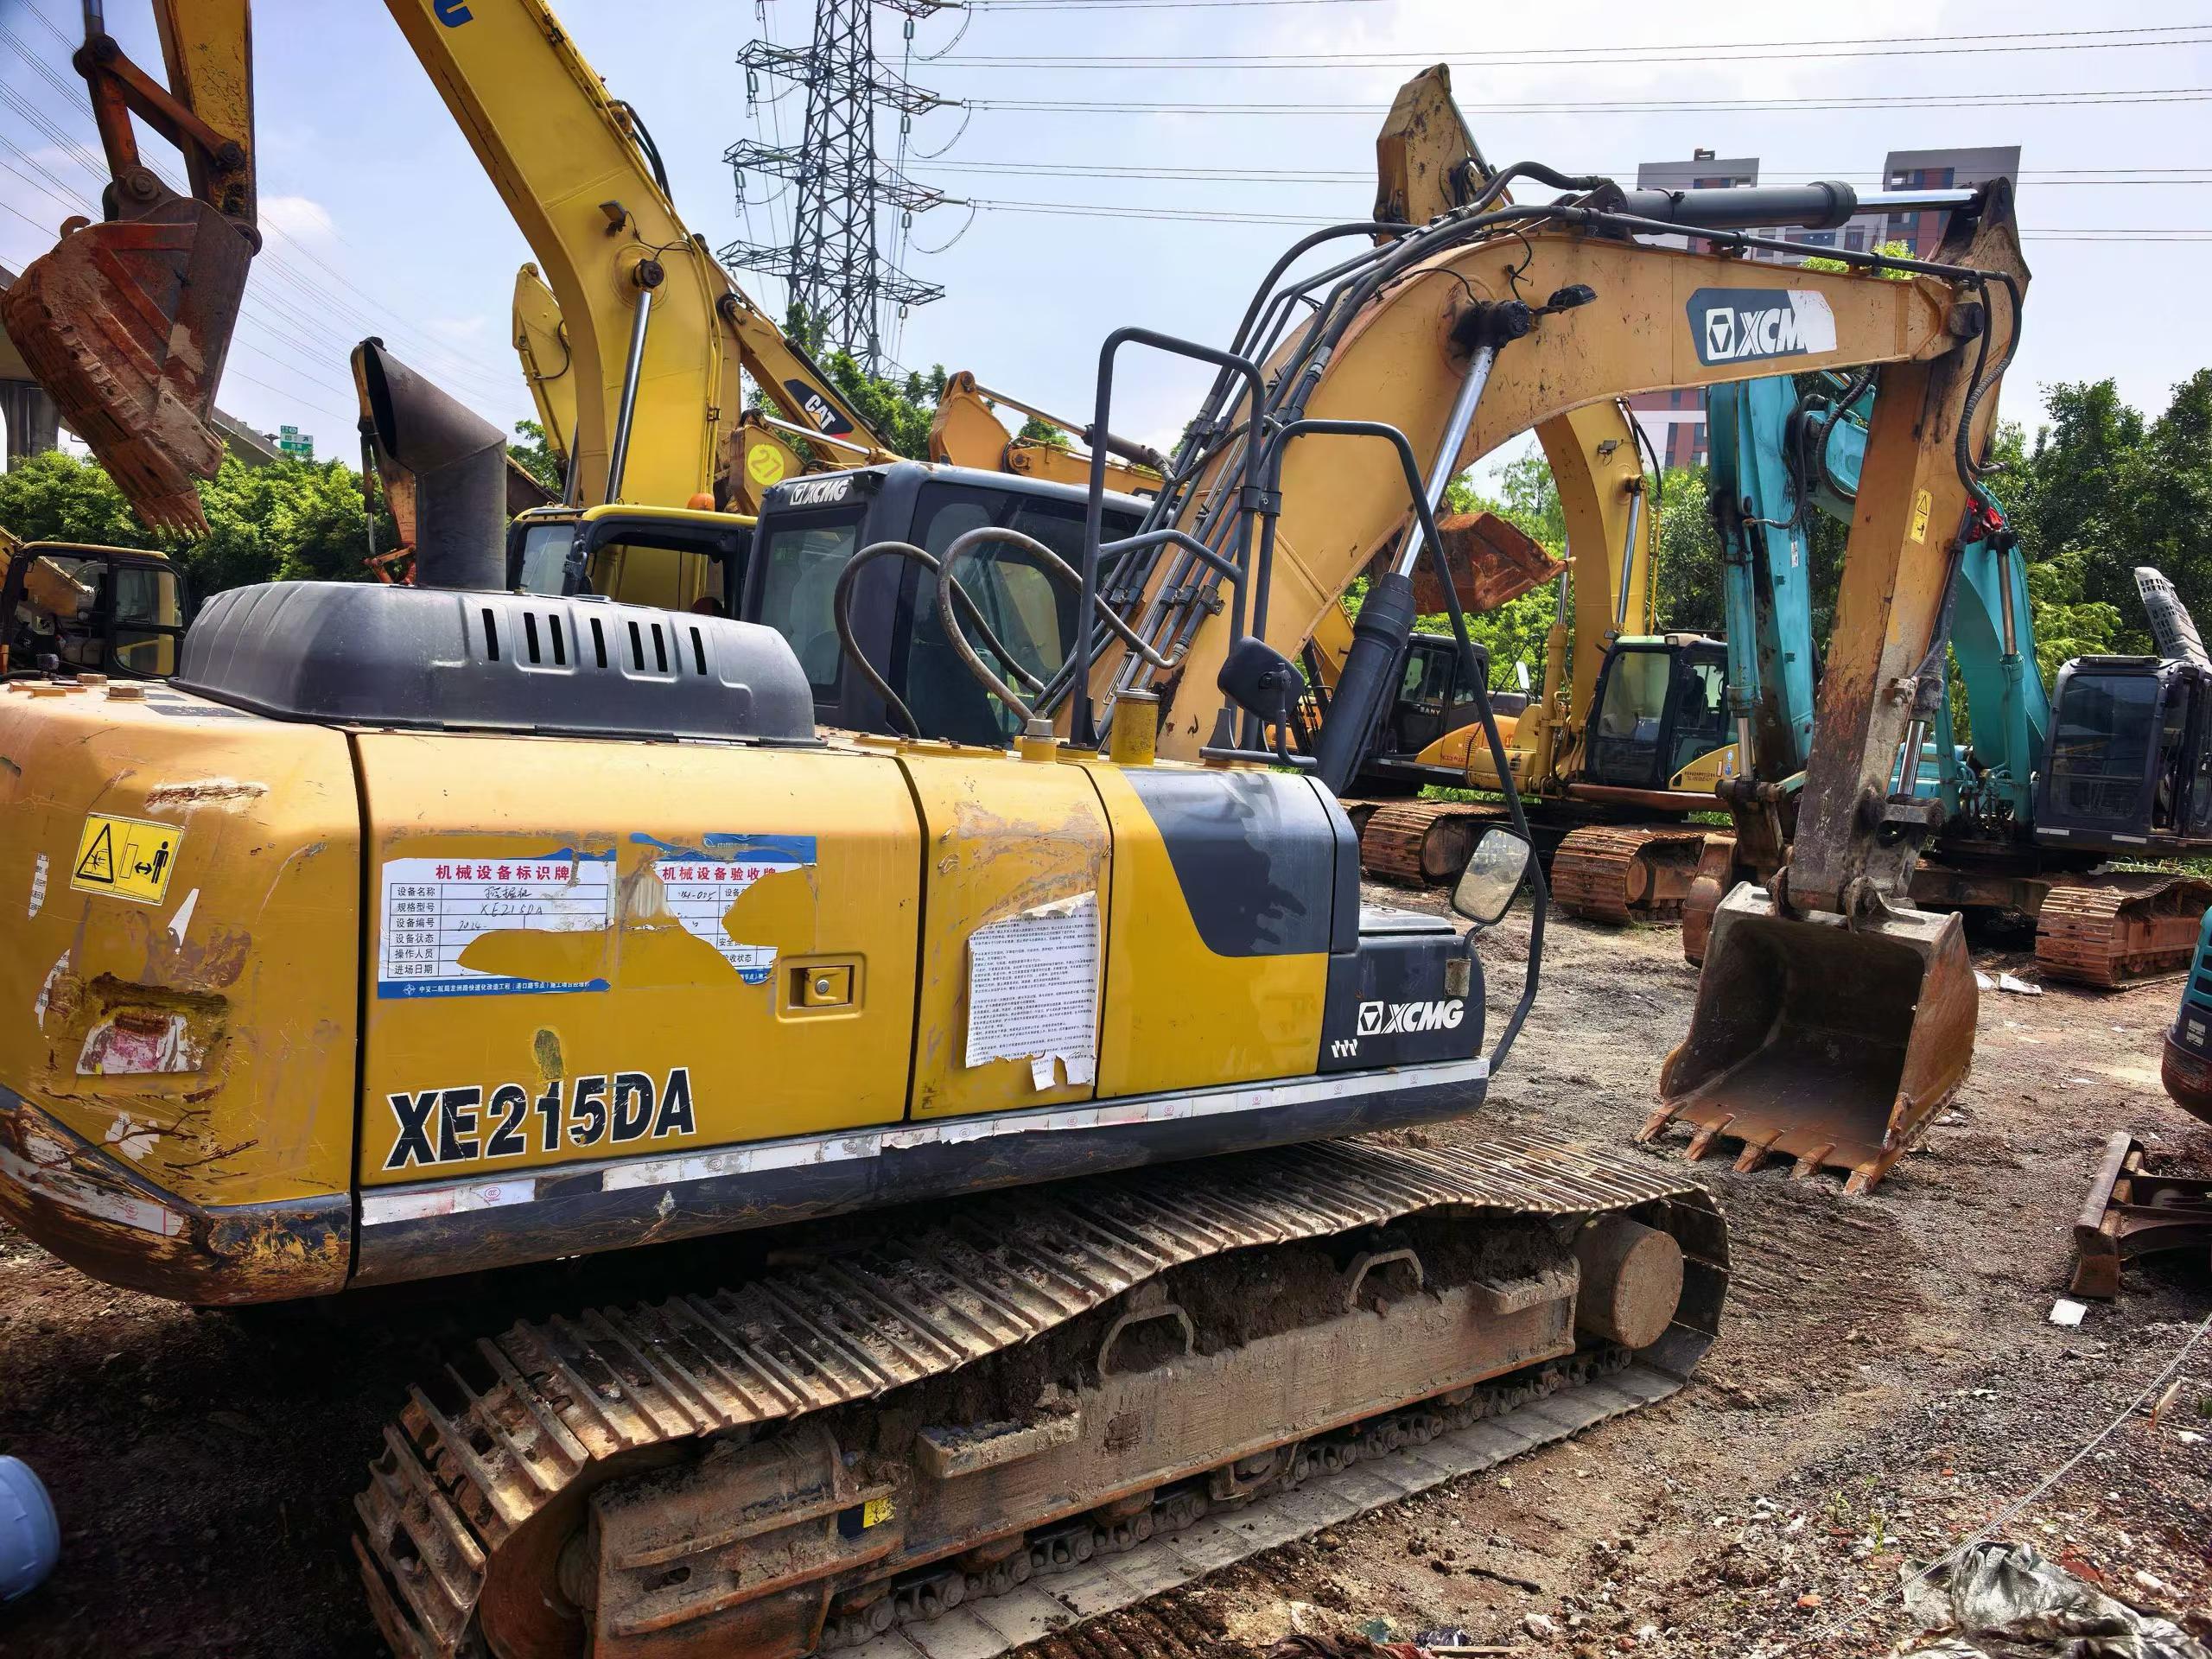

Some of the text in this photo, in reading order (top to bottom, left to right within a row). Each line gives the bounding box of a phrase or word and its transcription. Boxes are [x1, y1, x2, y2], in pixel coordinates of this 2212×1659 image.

[804, 394, 836, 430] CAT
[751, 449, 782, 478] 27
[802, 479, 849, 505] XCMG
[435, 864, 571, 880] 机械设备标识牌
[397, 887, 436, 897] 设备名称
[397, 902, 435, 912] 规格型号
[396, 918, 435, 928] 设备编号
[395, 933, 435, 944] 设备状态
[394, 949, 434, 959] 操作人员
[394, 964, 433, 975] 进场日期
[1381, 999, 1465, 1034] XCMG
[381, 1066, 697, 1171] XE215DA
